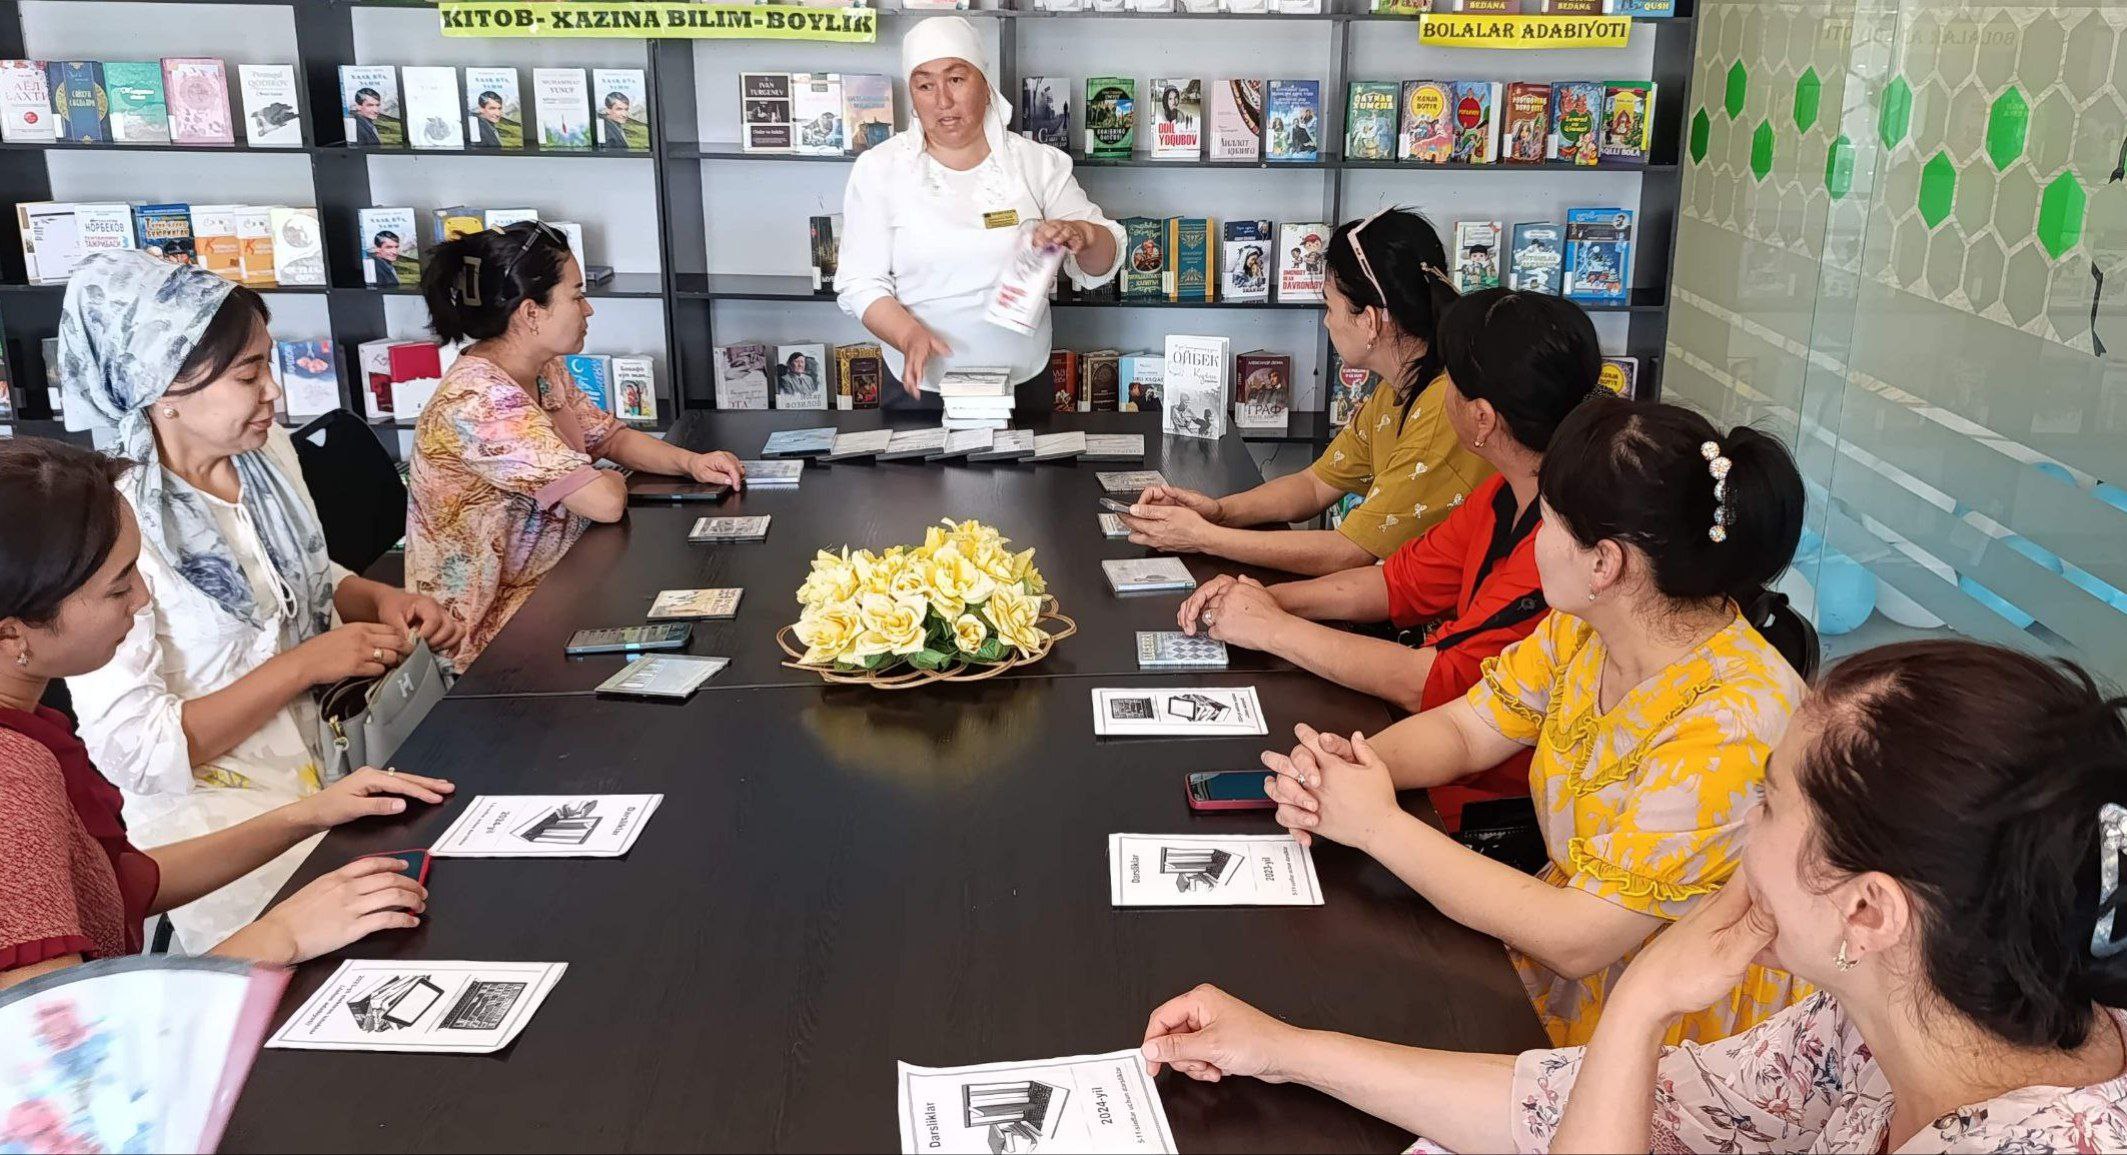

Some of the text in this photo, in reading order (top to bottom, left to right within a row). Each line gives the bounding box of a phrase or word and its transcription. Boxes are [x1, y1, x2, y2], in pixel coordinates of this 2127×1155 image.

[1469, 1, 1506, 10] BEDANA
[1557, 2, 1591, 11] BEDANA
[1643, 2, 1669, 11] QUSH
[552, 9, 661, 29] XAZINA
[667, 9, 873, 34] BILIM-BOYLIK
[1423, 19, 1627, 39] BOLALAR ADABIYOTI
[1158, 122, 1175, 134] ODIL
[1158, 134, 1197, 146] YOQUBOV
[85, 222, 125, 233] НОРБЕКОВ
[1173, 349, 1220, 368] ОЙБЕК
[1248, 405, 1282, 416] ГРАФ
[1091, 1087, 1113, 1126] 2024-yil
[924, 1102, 941, 1148] Darsliklar
